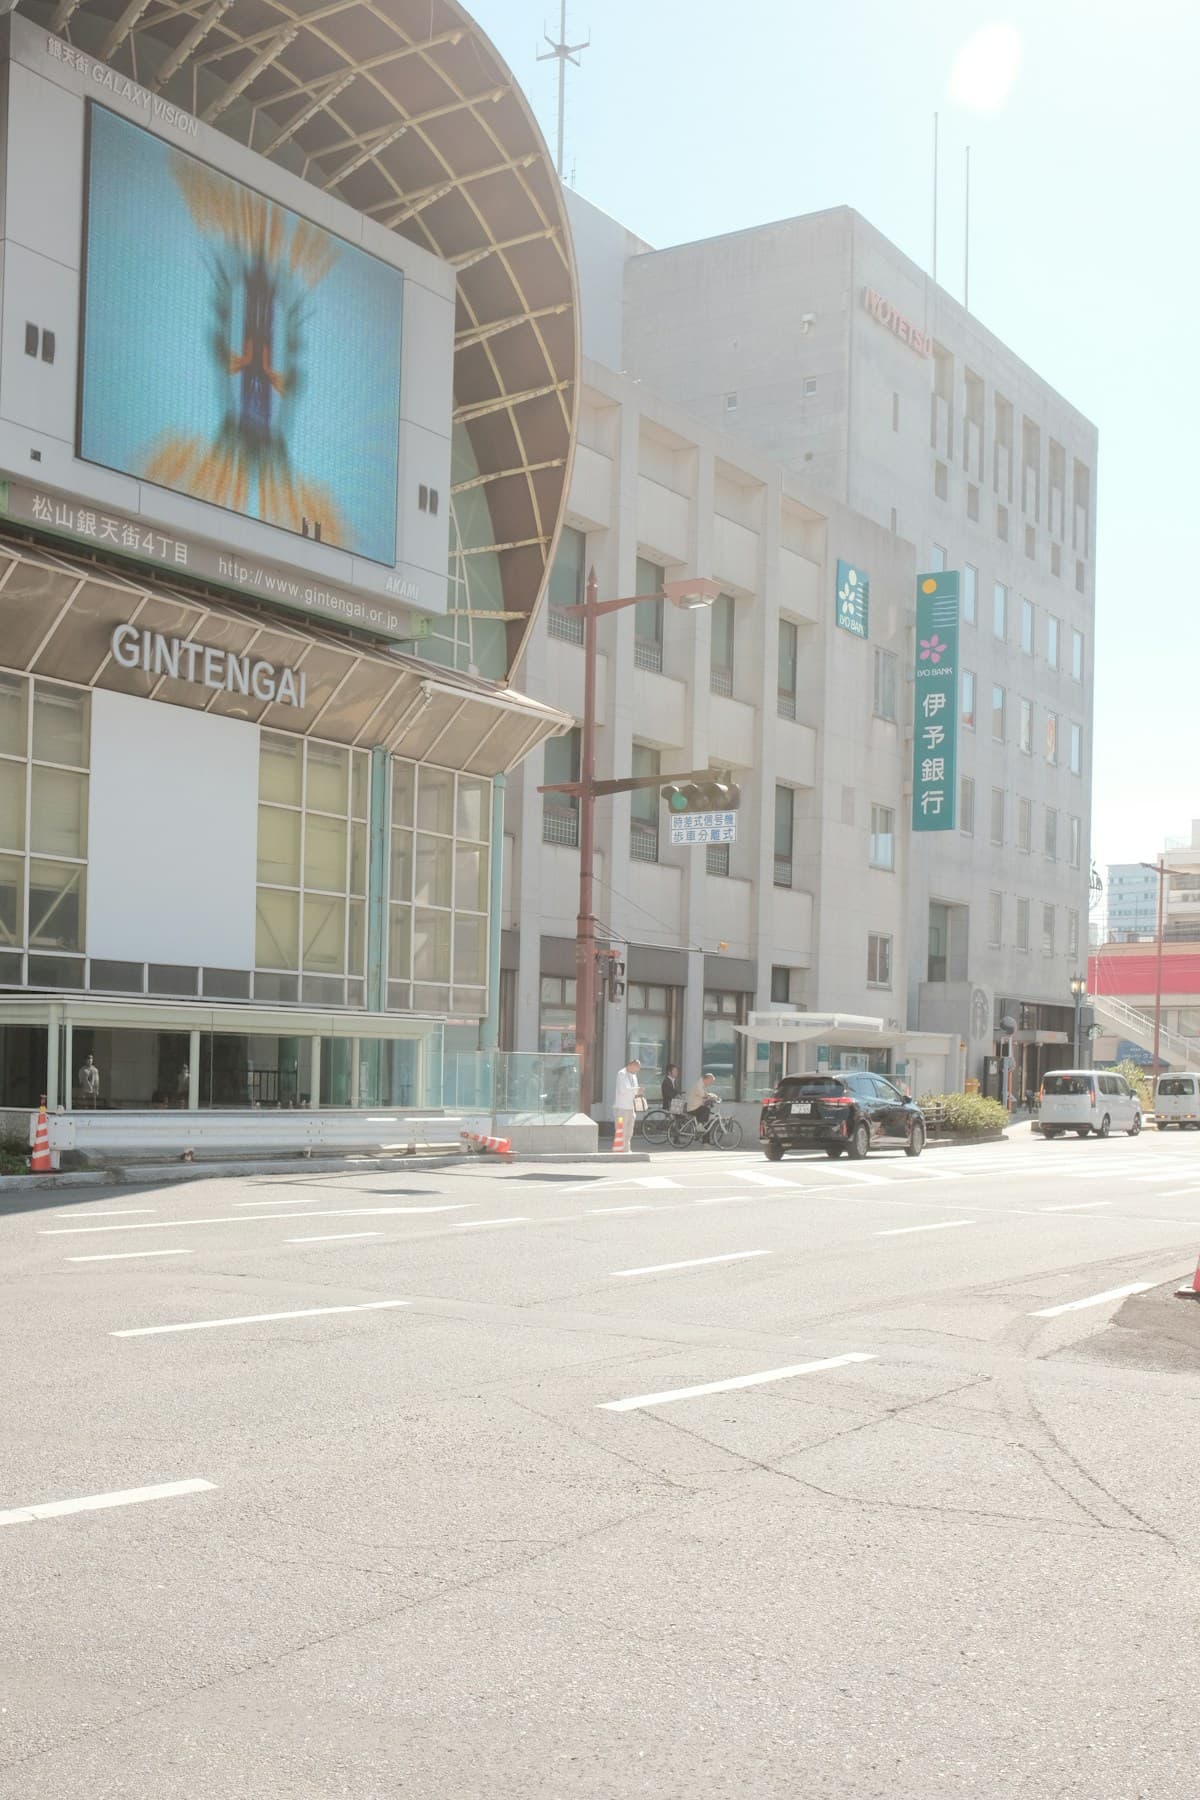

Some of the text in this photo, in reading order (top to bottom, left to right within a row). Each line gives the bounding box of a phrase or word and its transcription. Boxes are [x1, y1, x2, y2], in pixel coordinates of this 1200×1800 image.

[48, 38, 200, 137] 銀天街 GALAXY VISION
[865, 287, 933, 355] IYOTETSU
[32, 495, 188, 565] 松山銀天街4丁目
[385, 576, 420, 600] AKAMI
[112, 623, 307, 708] GINTENGAI
[917, 667, 953, 677] IYO BANK
[921, 693, 946, 814] 伊予銀行
[673, 828, 734, 842] 歩車分離式
